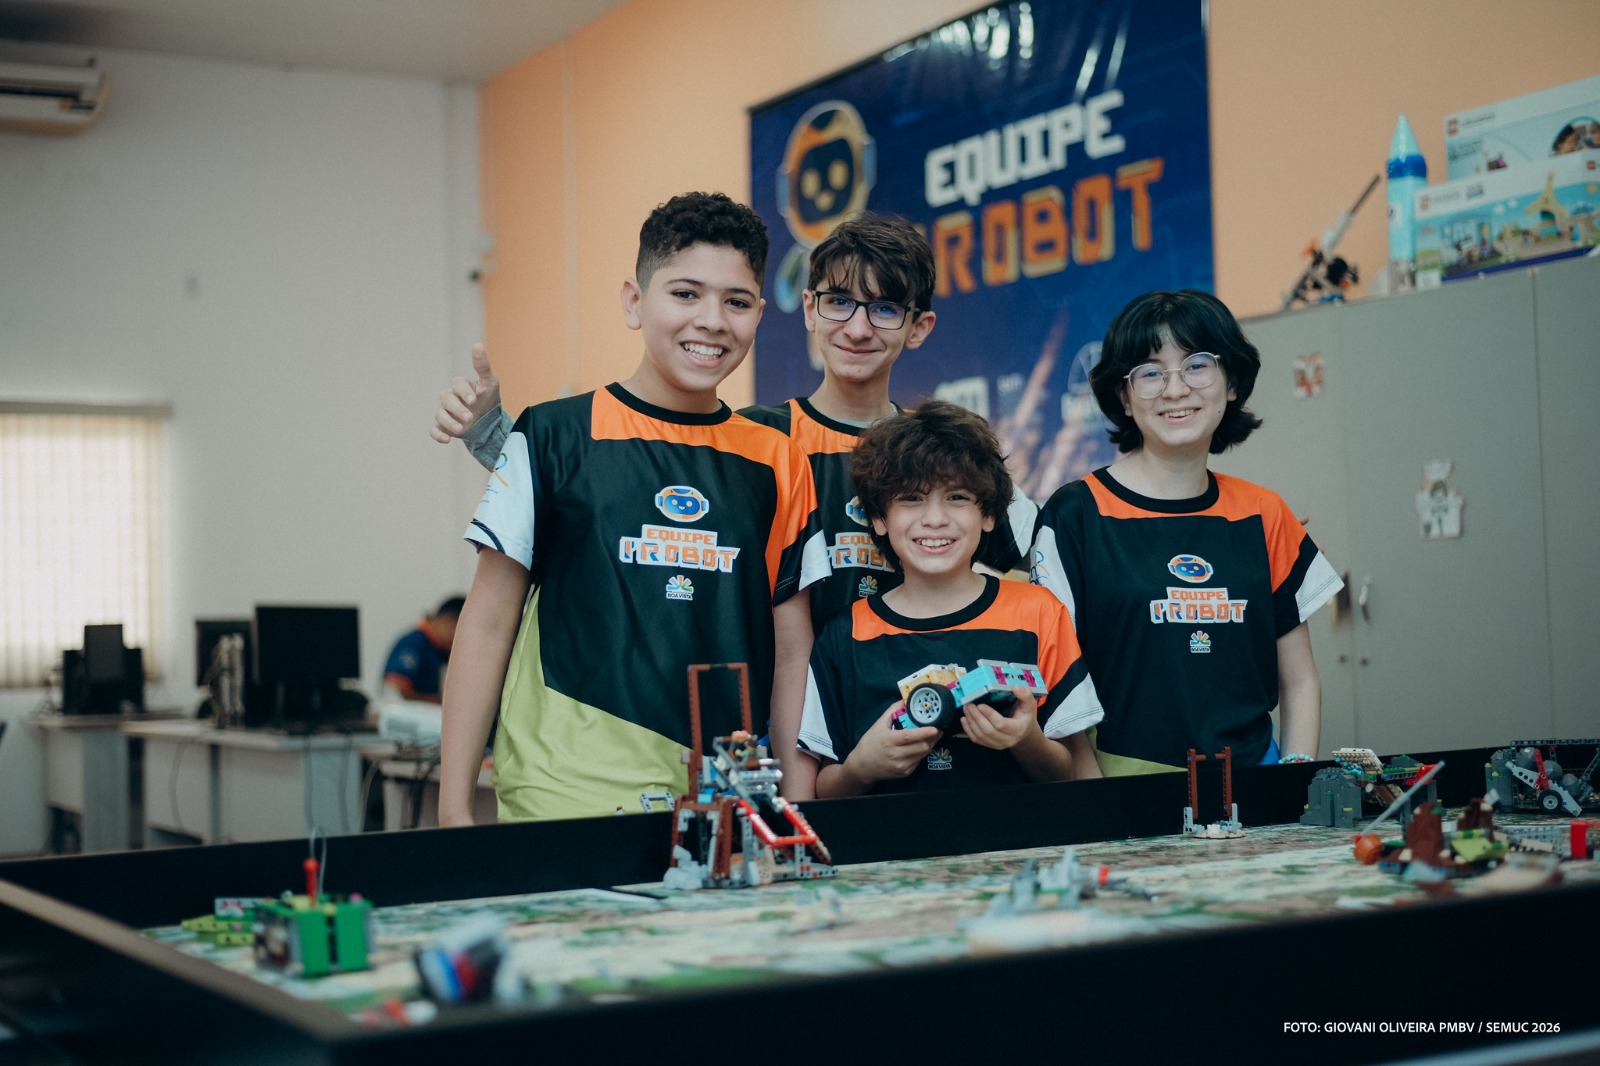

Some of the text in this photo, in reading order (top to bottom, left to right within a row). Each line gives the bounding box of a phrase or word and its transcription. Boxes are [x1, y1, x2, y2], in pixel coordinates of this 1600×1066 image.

[924, 89, 1125, 208] EQUIPE
[646, 528, 715, 546] EQUIPE
[840, 535, 877, 546] EQU
[1170, 590, 1227, 601] EQUIPE
